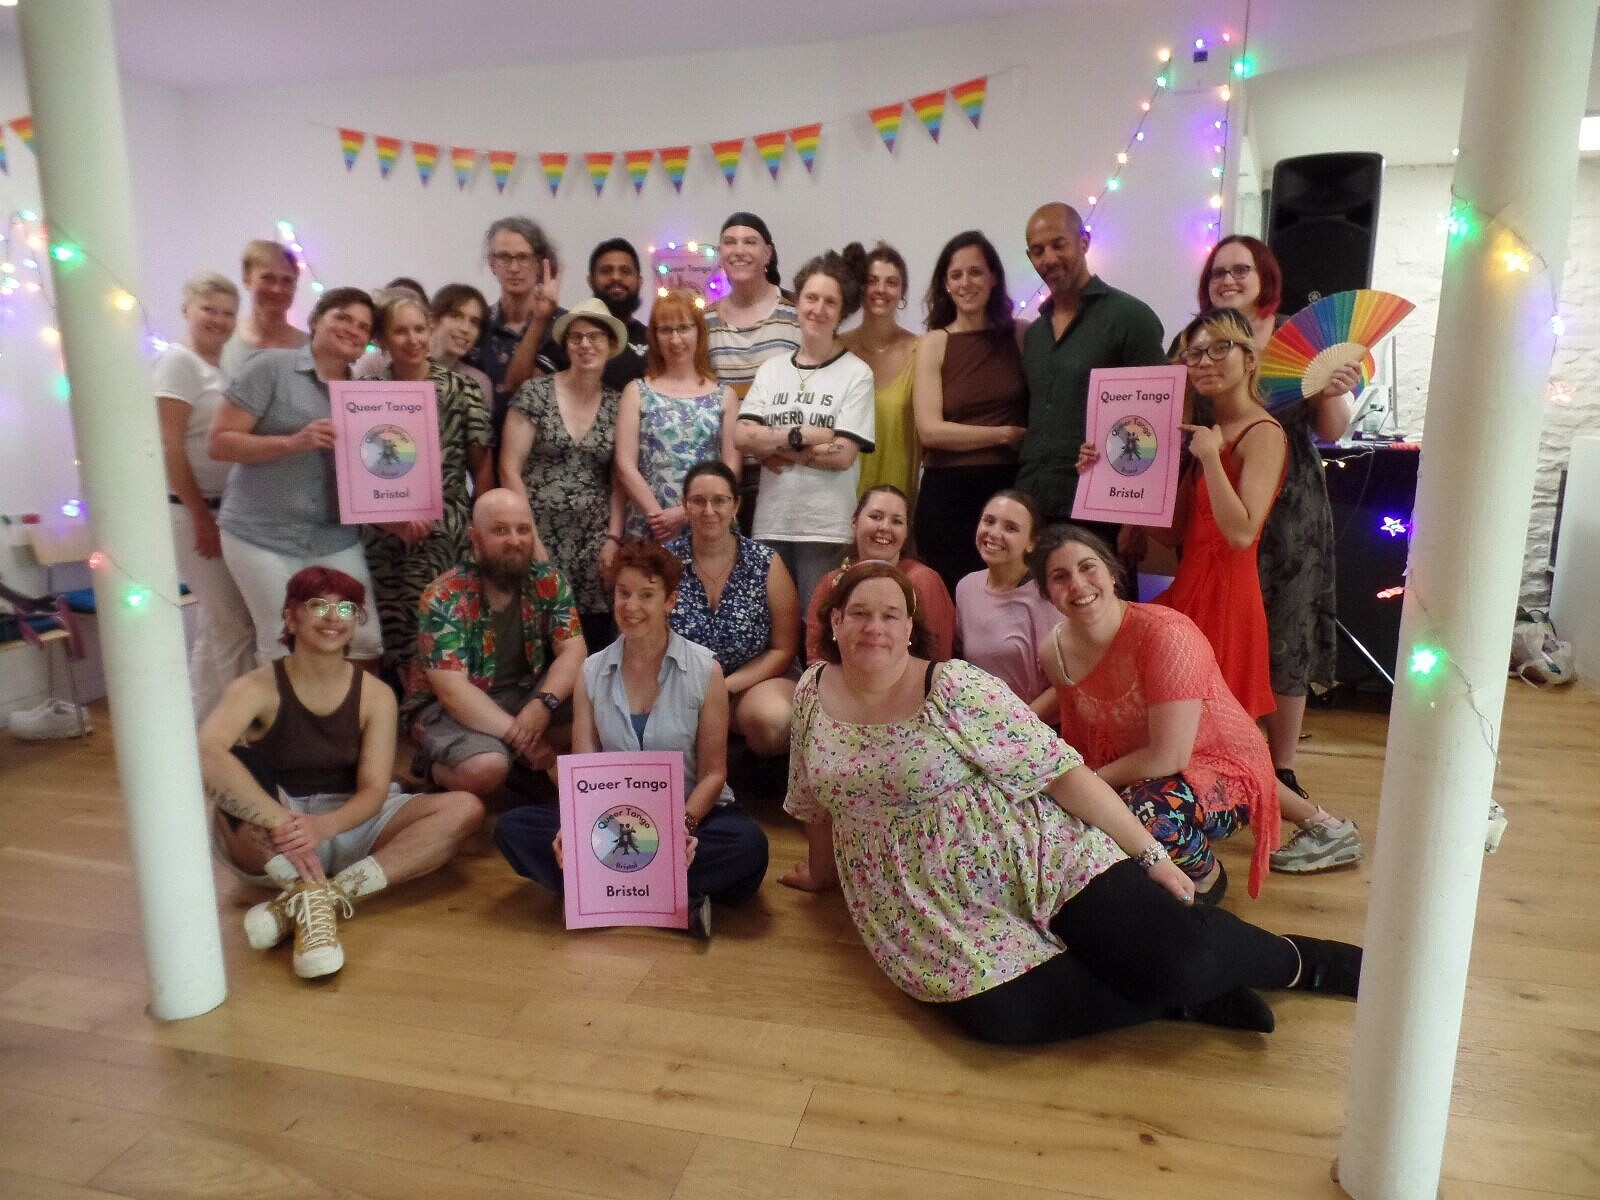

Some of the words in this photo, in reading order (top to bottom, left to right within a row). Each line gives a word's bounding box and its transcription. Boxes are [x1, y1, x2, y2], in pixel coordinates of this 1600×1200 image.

[794, 392, 815, 405] XIU
[820, 393, 834, 406] IS
[1101, 391, 1133, 403] Queer
[1136, 390, 1170, 403] Tango
[346, 401, 382, 413] Queer
[385, 401, 422, 413] Tango
[809, 412, 835, 428] UNO
[373, 488, 410, 499] Bristol
[1109, 487, 1145, 499] Bristol
[576, 780, 621, 793] Queer
[624, 777, 668, 792] Tango
[598, 810, 623, 830] Queer
[625, 807, 651, 829] Tango
[606, 885, 650, 897] Bristol
